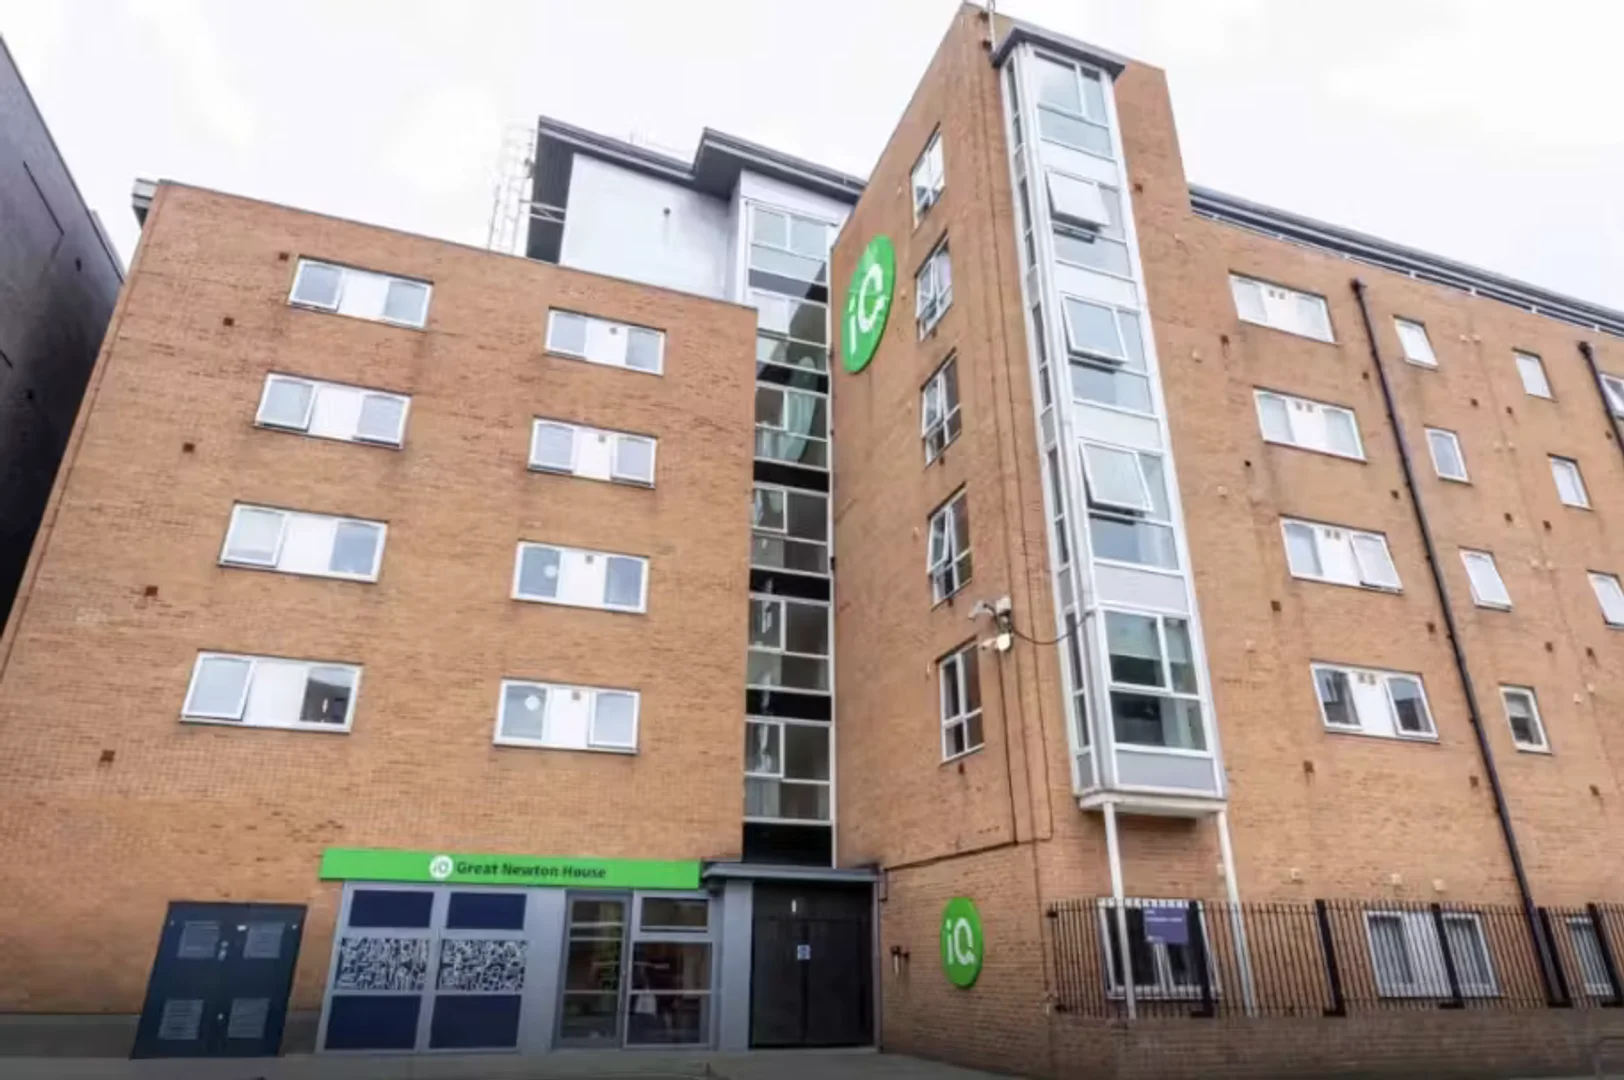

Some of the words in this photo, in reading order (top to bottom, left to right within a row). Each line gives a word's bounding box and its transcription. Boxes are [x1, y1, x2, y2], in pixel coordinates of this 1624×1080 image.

[457, 861, 498, 876] Great
[502, 862, 558, 878] Newton
[562, 864, 606, 878] House
[946, 917, 975, 965] iQ
